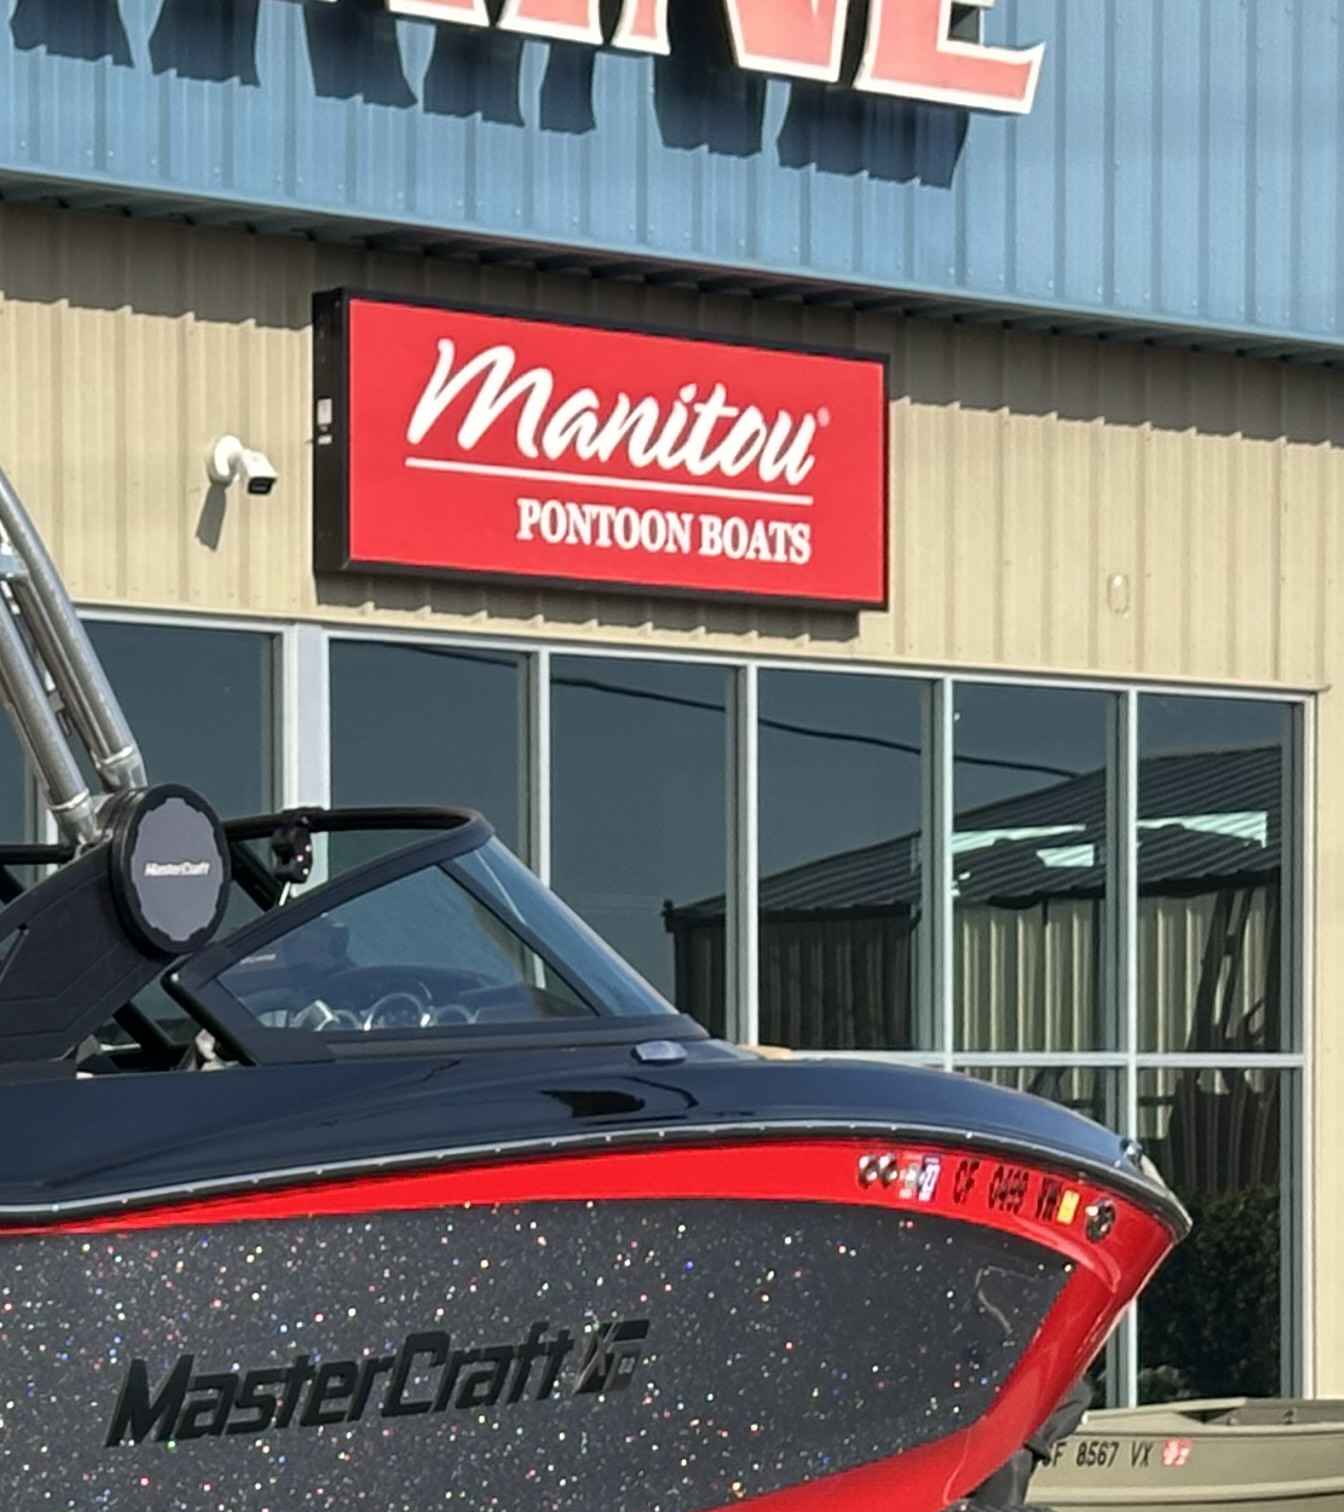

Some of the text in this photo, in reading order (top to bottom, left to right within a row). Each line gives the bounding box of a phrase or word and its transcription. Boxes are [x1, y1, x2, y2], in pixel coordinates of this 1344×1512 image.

[406, 338, 816, 486] Manitou
[516, 497, 812, 565] PONTOON BOATS
[105, 1320, 575, 1448] MasterCraft
[1076, 1441, 1120, 1468] 8567
[1130, 1441, 1154, 1468] VX
